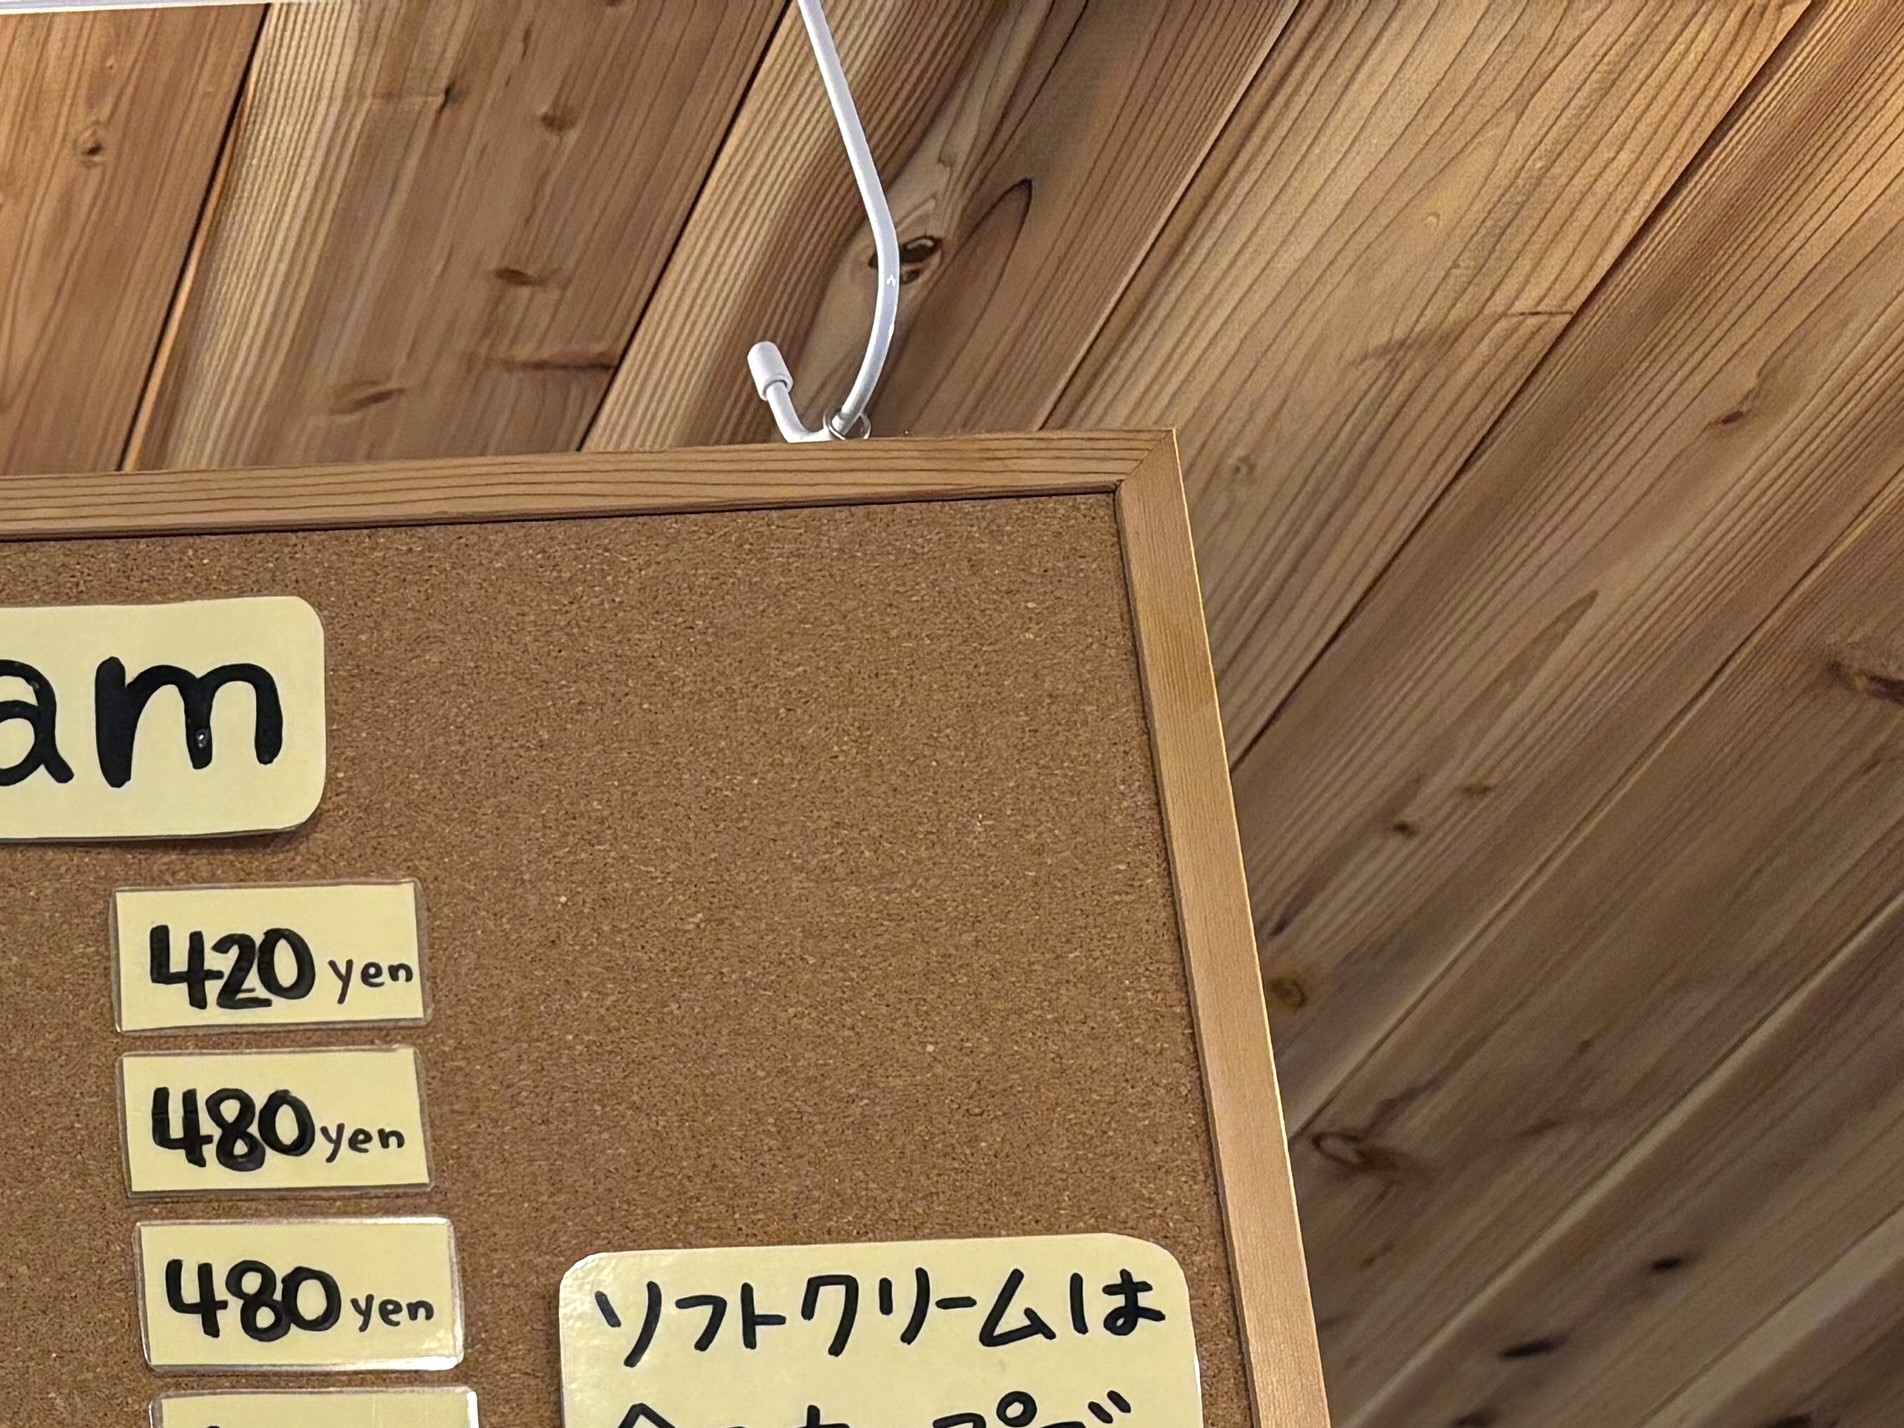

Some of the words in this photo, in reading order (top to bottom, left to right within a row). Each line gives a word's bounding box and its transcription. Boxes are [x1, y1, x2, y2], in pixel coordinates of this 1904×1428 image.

[595, 1267, 1166, 1368] ソフトクリームは
